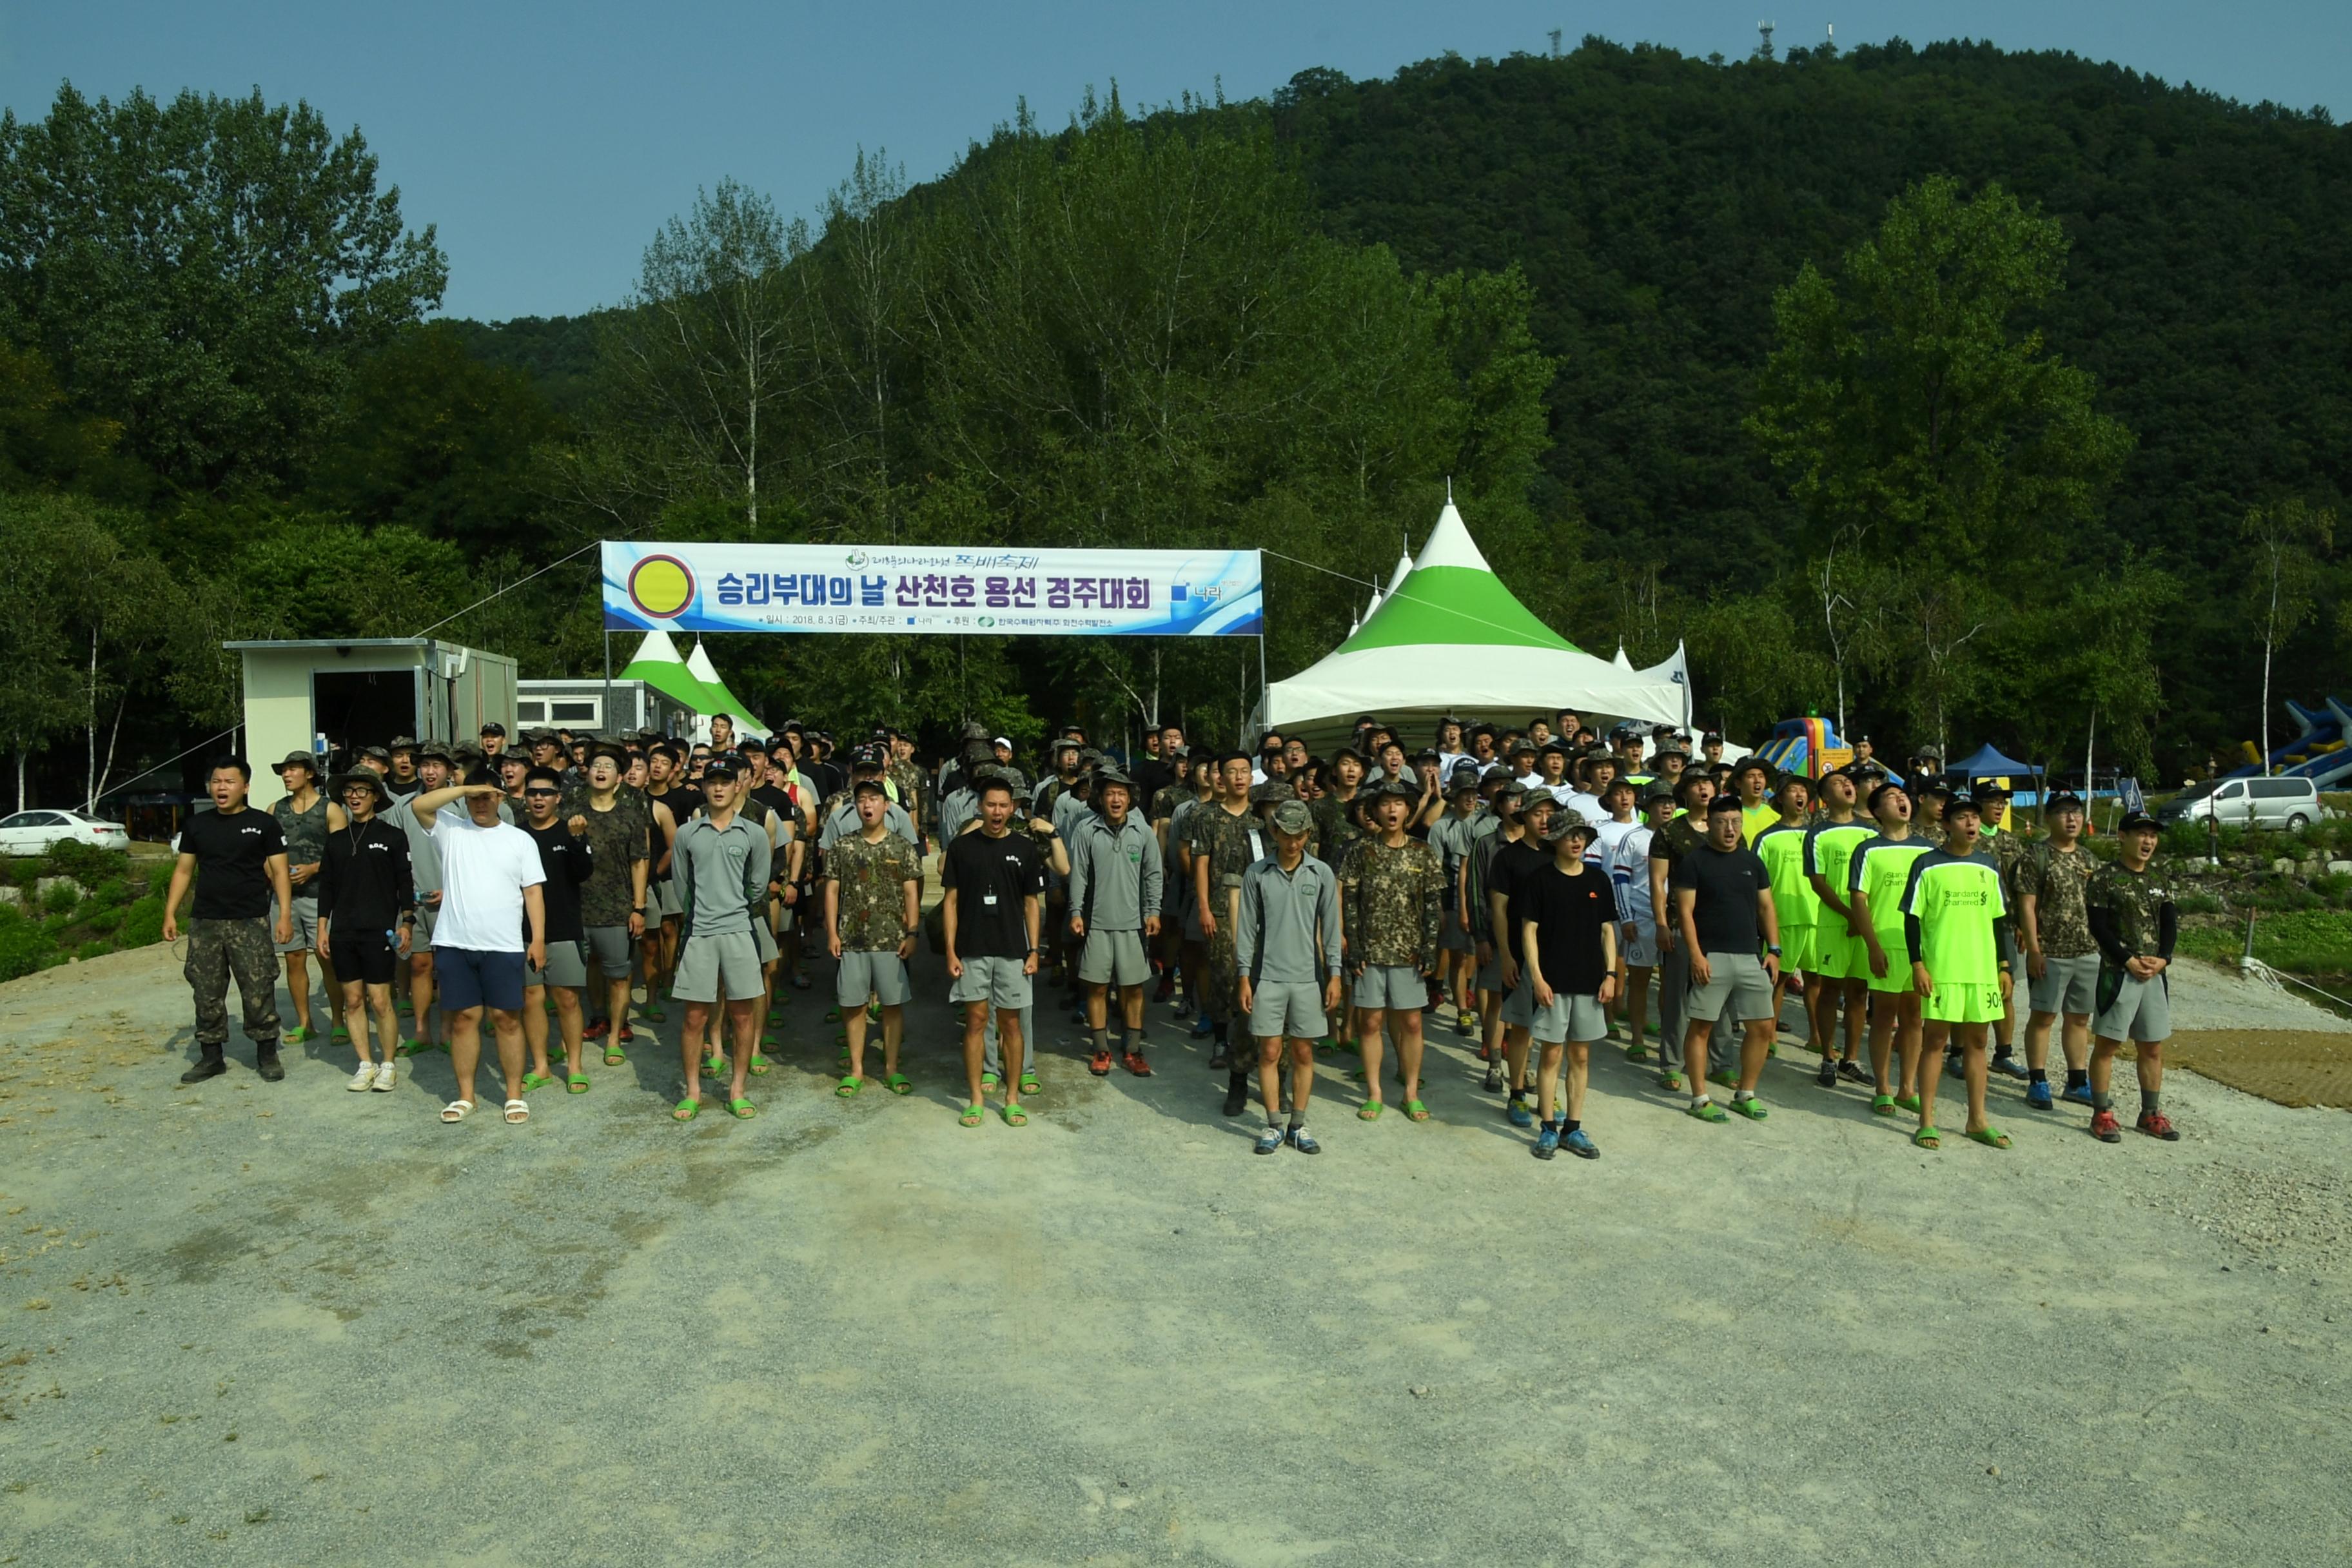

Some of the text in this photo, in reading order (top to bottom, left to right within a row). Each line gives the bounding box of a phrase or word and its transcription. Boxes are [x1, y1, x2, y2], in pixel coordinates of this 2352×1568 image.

[956, 553, 1039, 571] 쪽배축제
[716, 573, 1150, 609] 승리부대의 날 산천호 용선 경주대회
[1195, 587, 1222, 601] 나라
[766, 615, 783, 625] 일시
[859, 615, 895, 625] 주최/주관
[954, 616, 969, 625] 후원
[1944, 899, 1979, 907] Chartered
